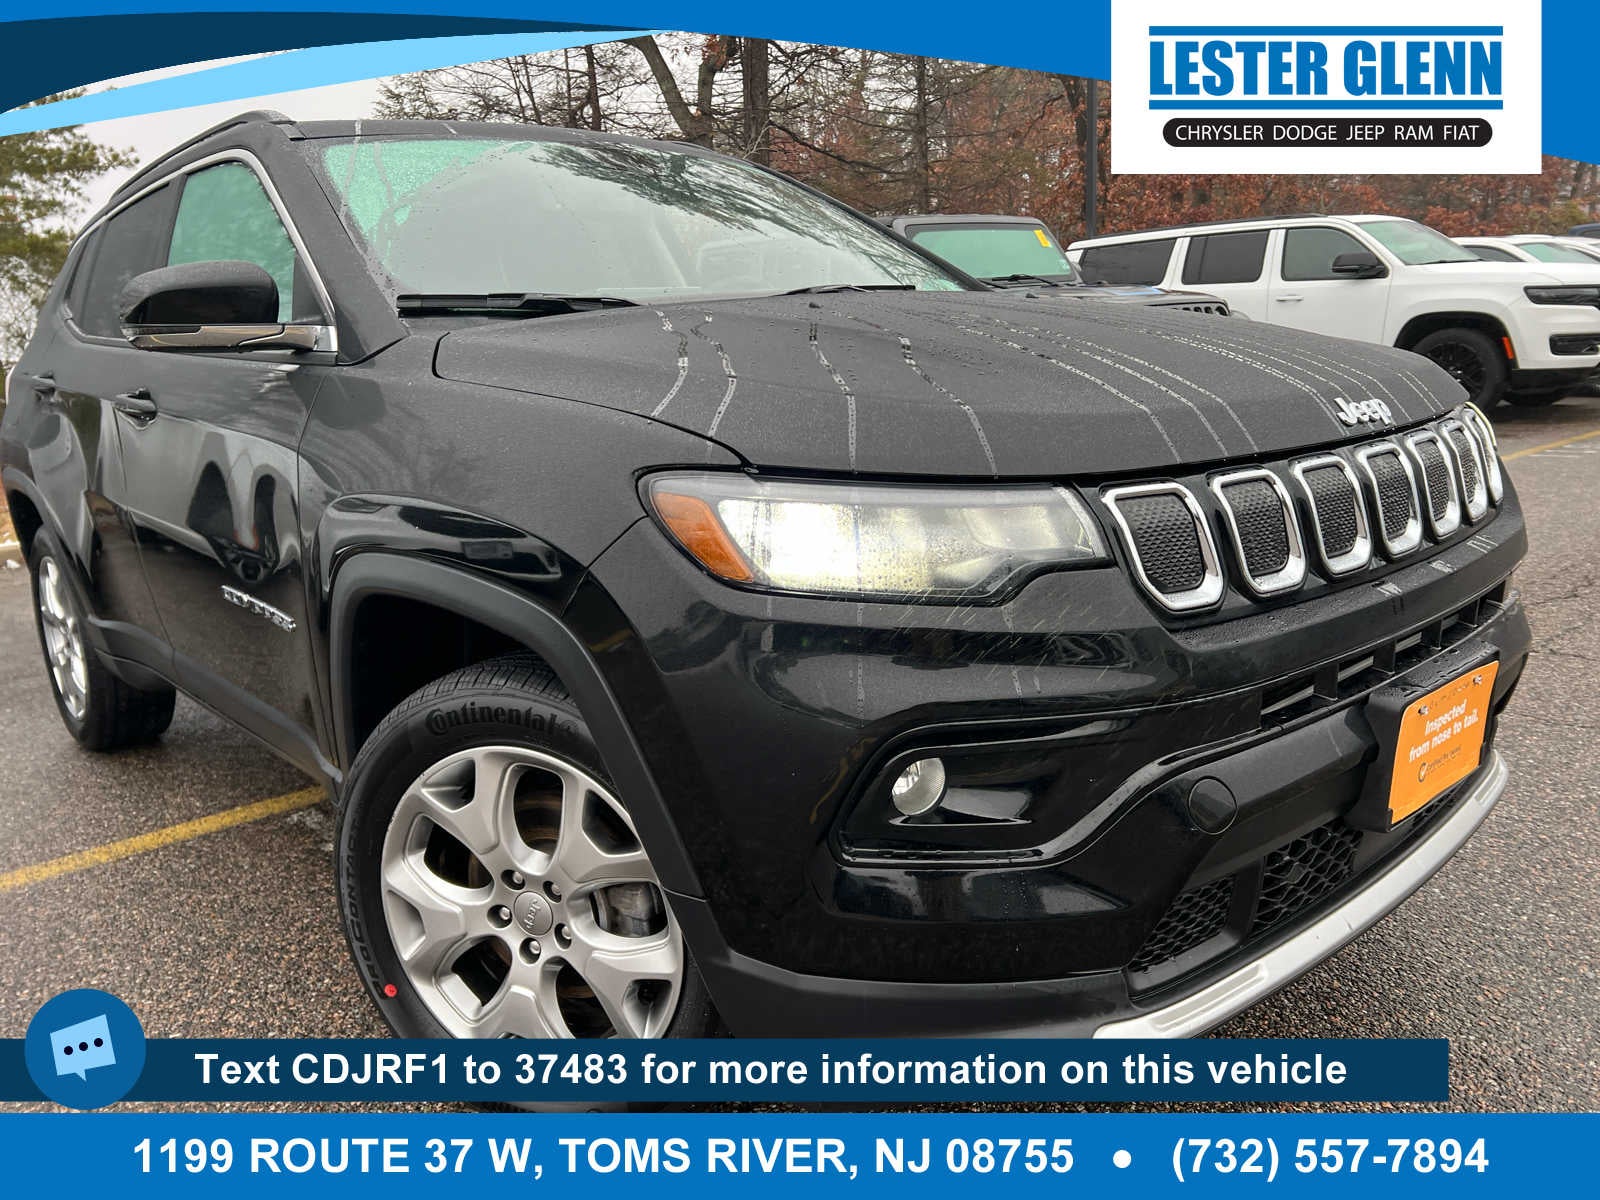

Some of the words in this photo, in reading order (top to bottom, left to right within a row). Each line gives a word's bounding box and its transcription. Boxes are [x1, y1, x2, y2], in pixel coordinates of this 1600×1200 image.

[1334, 397, 1391, 426] Jeep
[425, 702, 558, 735] Continental
[1425, 699, 1467, 735] Inspected
[1409, 741, 1429, 763] from
[1432, 728, 1451, 748] nose
[1453, 721, 1462, 735] to
